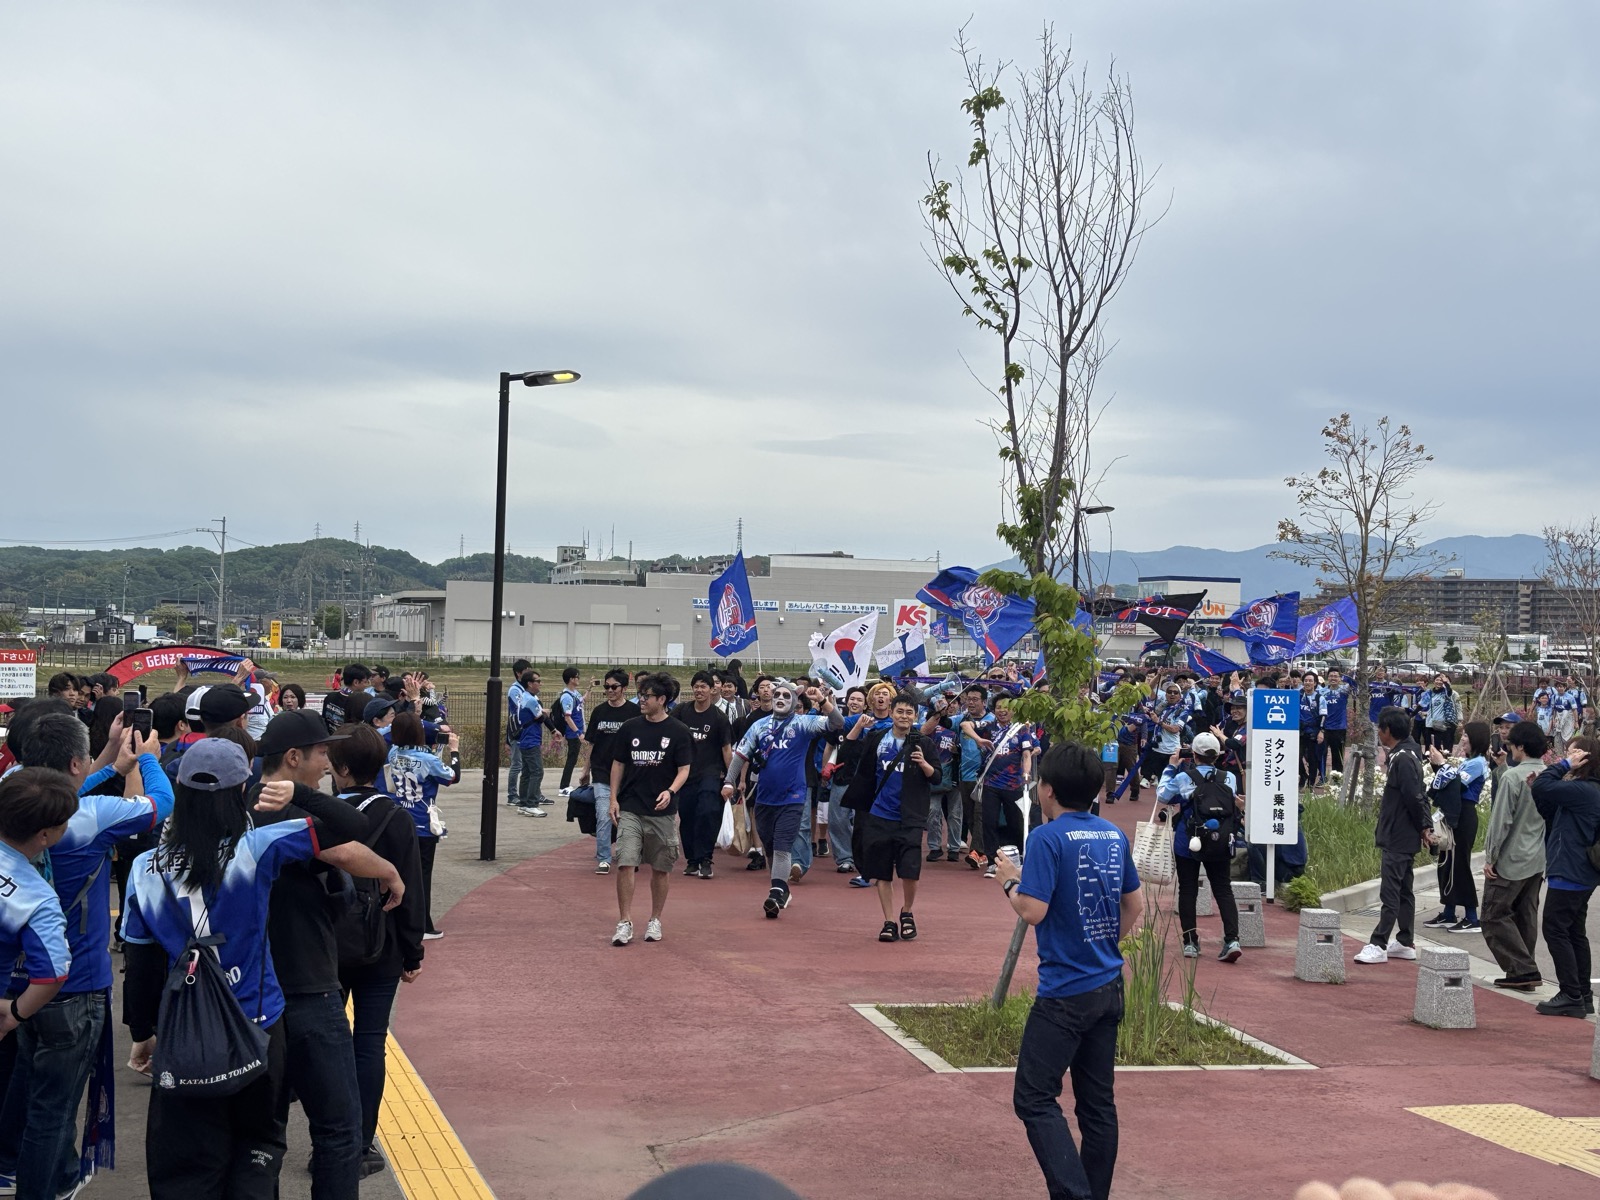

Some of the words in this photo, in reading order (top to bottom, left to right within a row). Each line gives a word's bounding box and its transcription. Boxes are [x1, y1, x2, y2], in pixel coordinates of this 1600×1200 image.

[1263, 695, 1290, 705] TAXI
[1264, 737, 1272, 757] TAXI
[1264, 759, 1272, 787] STAND
[1272, 737, 1286, 836] タクシー乗降場
[179, 1073, 228, 1085] KATALLER
[228, 1059, 262, 1079] TOYAMA
